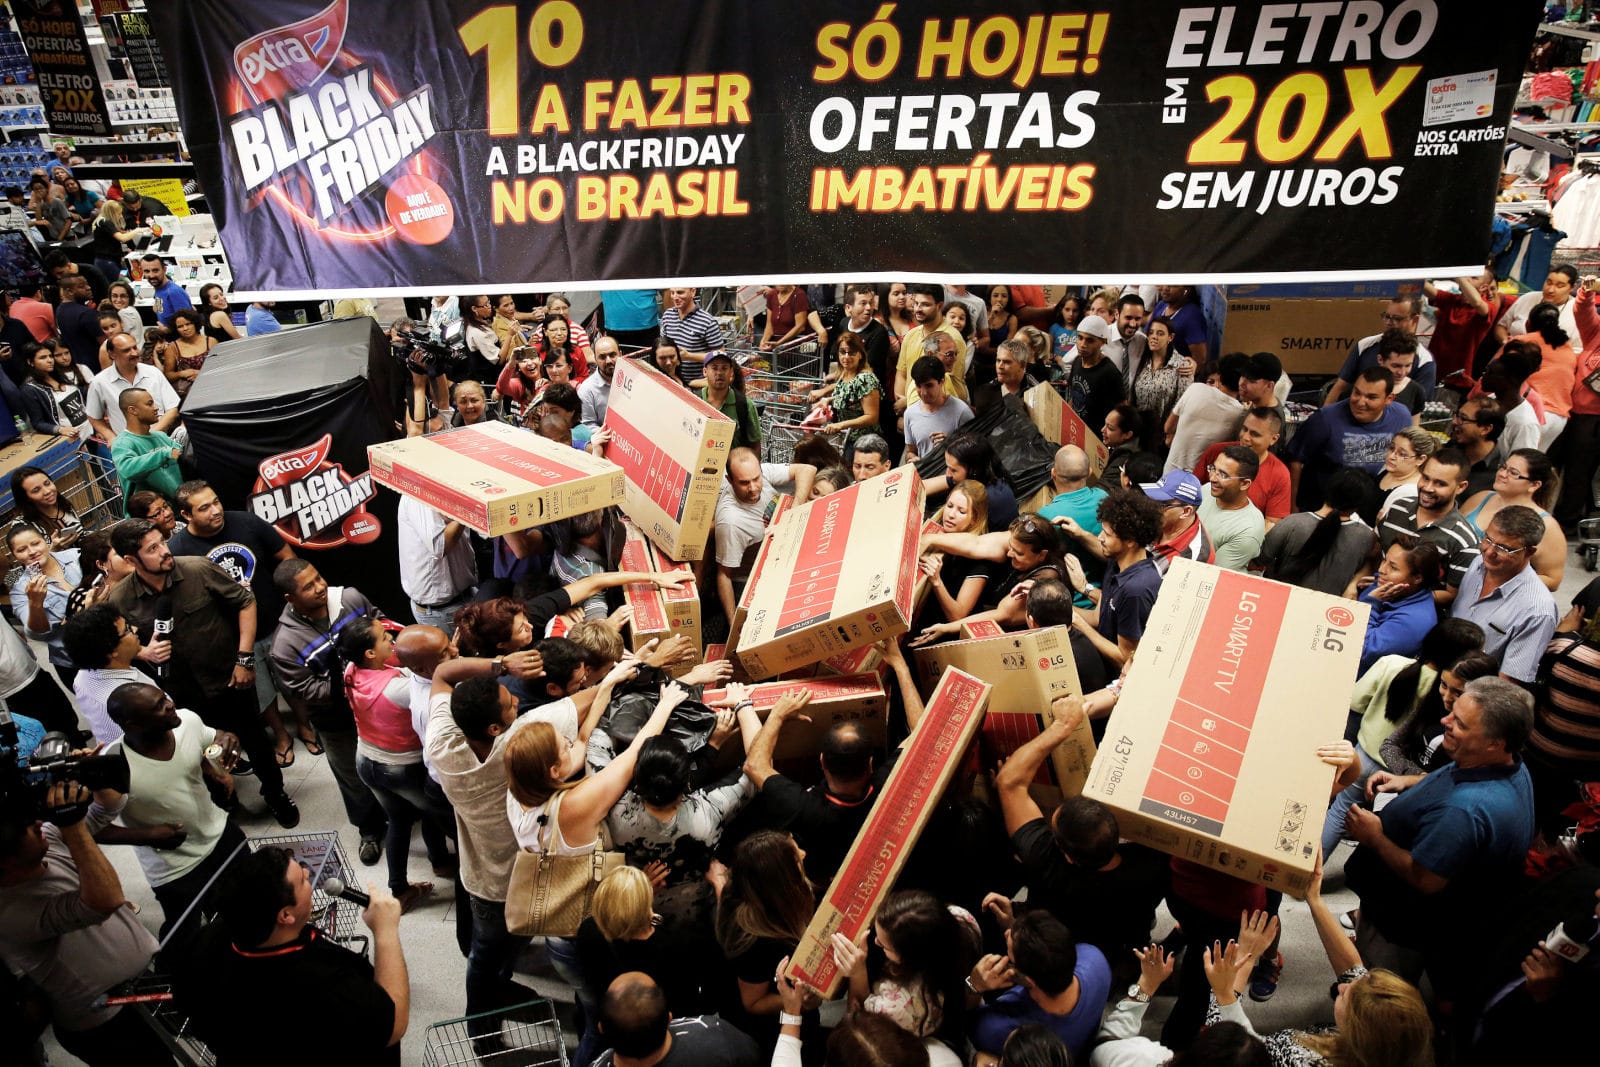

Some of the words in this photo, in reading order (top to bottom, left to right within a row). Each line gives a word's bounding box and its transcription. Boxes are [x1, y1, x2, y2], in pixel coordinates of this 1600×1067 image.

[26, 36, 82, 52] OFERTAS
[813, 3, 901, 82] SÓ
[917, 13, 1110, 88] HOJE!
[1166, 0, 1439, 68] ELETRO
[241, 37, 306, 85] extra
[39, 72, 93, 90] ELETRO
[1432, 84, 1457, 94] extra
[51, 89, 97, 112] 20X
[531, 84, 570, 134] A
[584, 73, 751, 131] FAZER
[1162, 77, 1189, 124] EM
[51, 112, 72, 122] SEM
[73, 112, 103, 124] JUROS
[809, 90, 1101, 153] OFERTAS
[1187, 65, 1424, 164] 20X
[230, 68, 383, 191] BLACK
[1417, 130, 1447, 144] NOS
[1448, 125, 1506, 142] CARTÕES
[306, 91, 436, 220] FRIDAY
[486, 146, 508, 176] A
[517, 133, 745, 174] BLACKFRIDAY
[1414, 143, 1459, 157] EXTRA
[810, 154, 1096, 211] IMBATÍVEIS
[1156, 170, 1256, 210] SEM
[1255, 166, 1405, 216] JUROS
[492, 179, 564, 224] NO
[577, 170, 748, 222] BRASIL
[399, 211, 413, 224] DE
[1231, 304, 1271, 312] SAMSUNG
[1281, 337, 1332, 350] SMART
[1334, 337, 1354, 350] TV
[623, 379, 633, 392] LG
[1070, 419, 1077, 434] LG
[616, 434, 636, 459] SMART
[634, 448, 644, 465] TV
[264, 456, 306, 481] extra
[541, 471, 563, 479] LG
[252, 467, 344, 525] BLACK
[470, 480, 492, 489] LG
[884, 484, 898, 498] LG
[297, 474, 374, 541] FRIDAY
[510, 504, 517, 515] LG
[828, 497, 841, 511] LG
[820, 511, 838, 540] SMART
[815, 540, 831, 555] TV
[1238, 591, 1261, 613] LG
[871, 622, 883, 633] LG
[1223, 613, 1253, 669] SMART
[1323, 627, 1346, 652] LG
[928, 661, 941, 677] LG
[1050, 655, 1064, 666] LG
[1214, 670, 1237, 694] TV
[1106, 735, 1134, 796] 43"/108cm
[1164, 808, 1199, 826] 43LH57
[880, 840, 897, 860] LG
[858, 859, 887, 905] SMART
[1262, 870, 1273, 883] LG
[847, 901, 865, 924] TV
